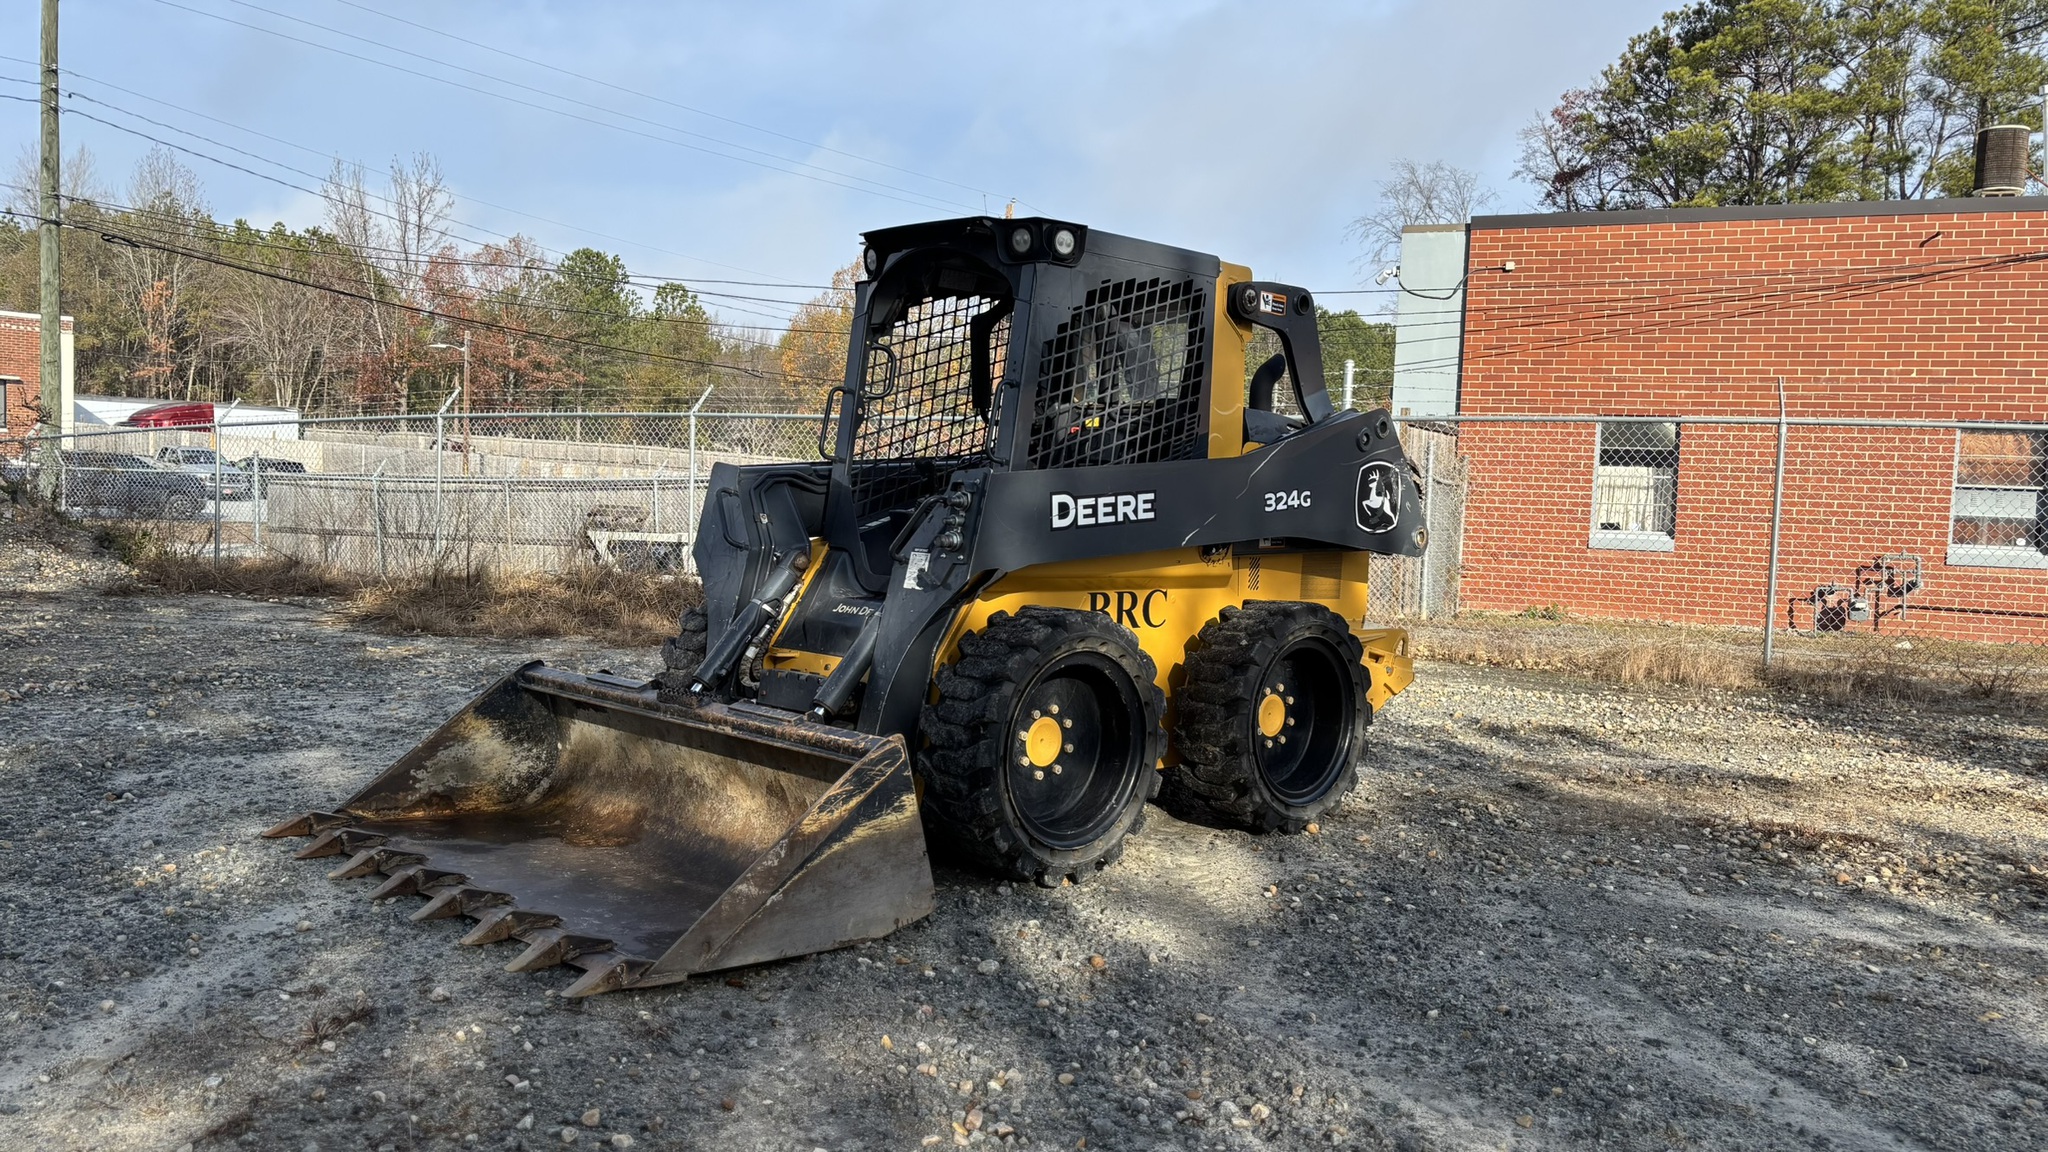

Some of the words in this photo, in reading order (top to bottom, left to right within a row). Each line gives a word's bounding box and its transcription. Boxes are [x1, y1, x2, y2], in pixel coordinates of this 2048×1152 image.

[1052, 493, 1155, 528] DEERE
[1264, 490, 1311, 512] 324G
[832, 603, 860, 615] JOHN
[1088, 589, 1167, 628] BRC
